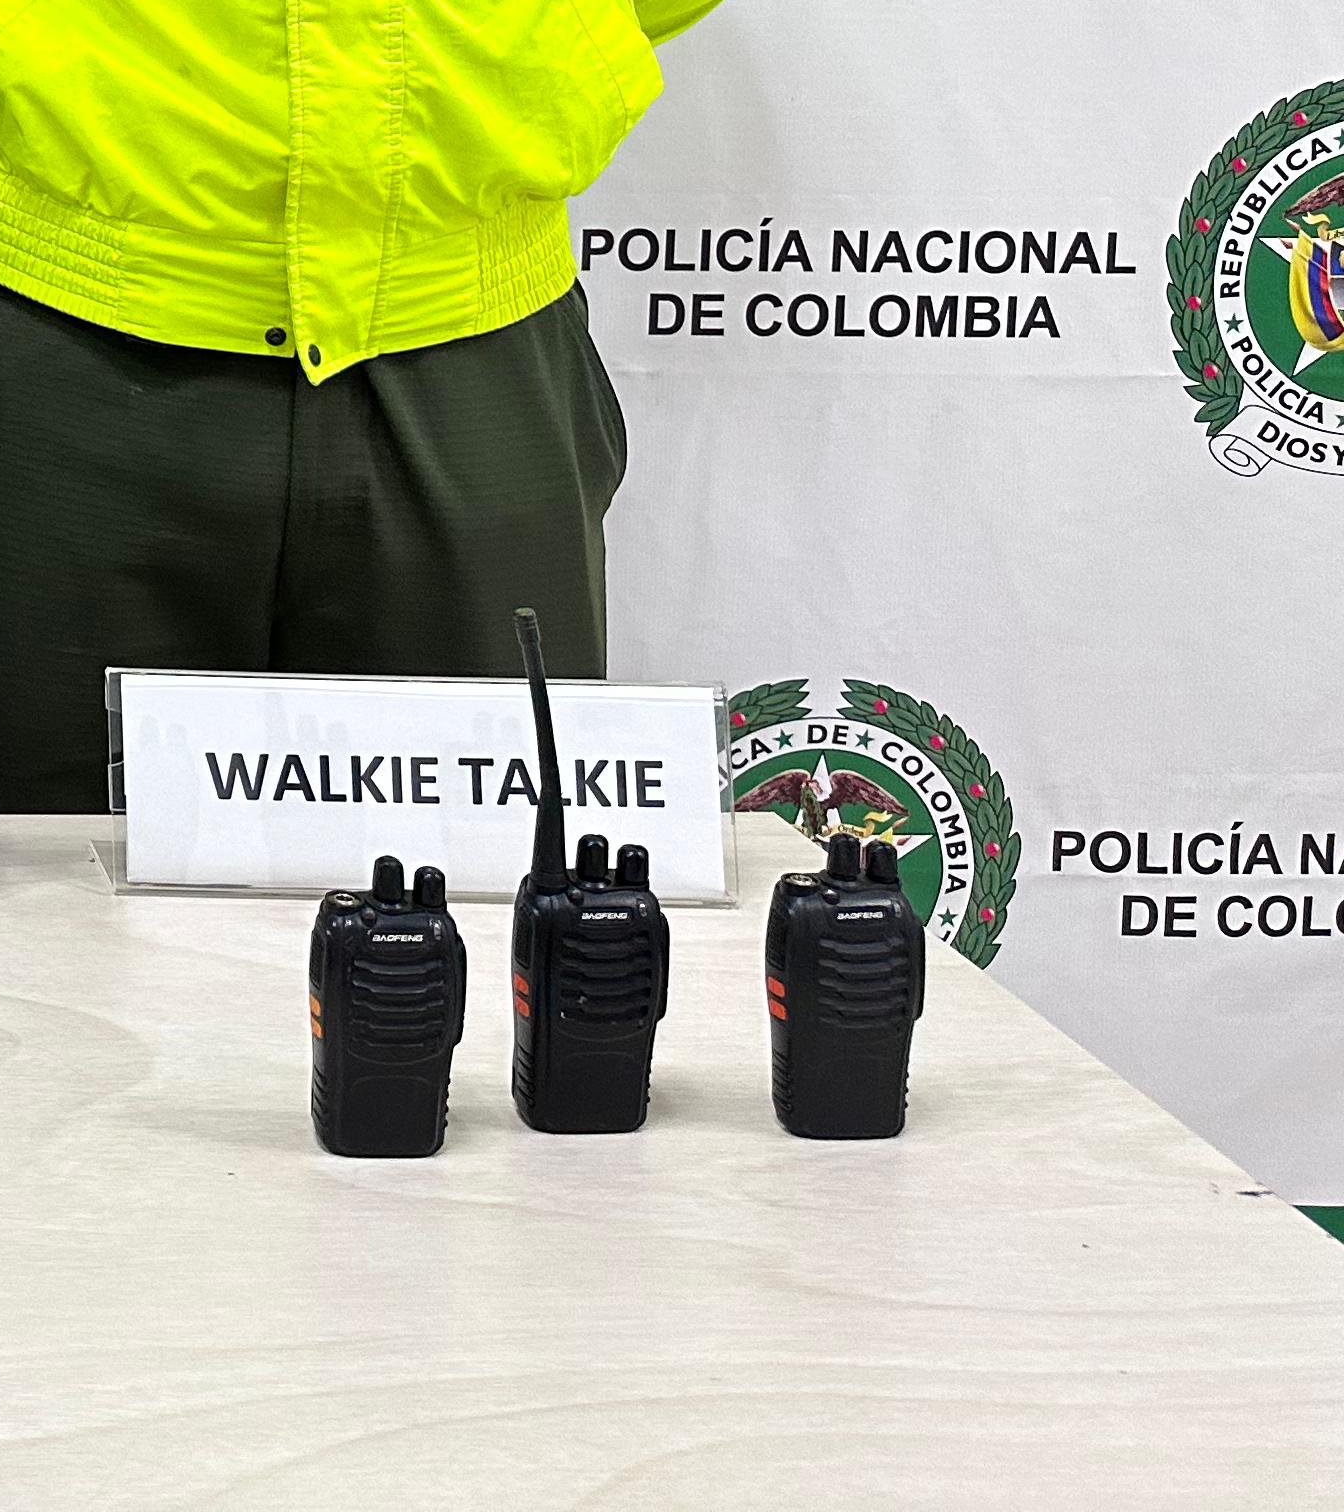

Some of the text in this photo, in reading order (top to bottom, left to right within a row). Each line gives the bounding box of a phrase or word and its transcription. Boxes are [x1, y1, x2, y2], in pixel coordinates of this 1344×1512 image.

[581, 217, 1137, 274] POLICÍA NACIONAL
[1219, 137, 1332, 299] REPÚBLICA
[648, 293, 1061, 339] DE COLOMBIA
[1230, 341, 1326, 425] POLICÍA
[205, 752, 440, 805] WALKIE
[458, 756, 666, 809] TAKIE
[807, 724, 969, 895] DE COLOMBIA
[1052, 821, 1284, 875] POLICÍA
[372, 934, 423, 943] BAOFENG
[581, 912, 628, 920] BAOFENG
[1122, 895, 1197, 938] DE
